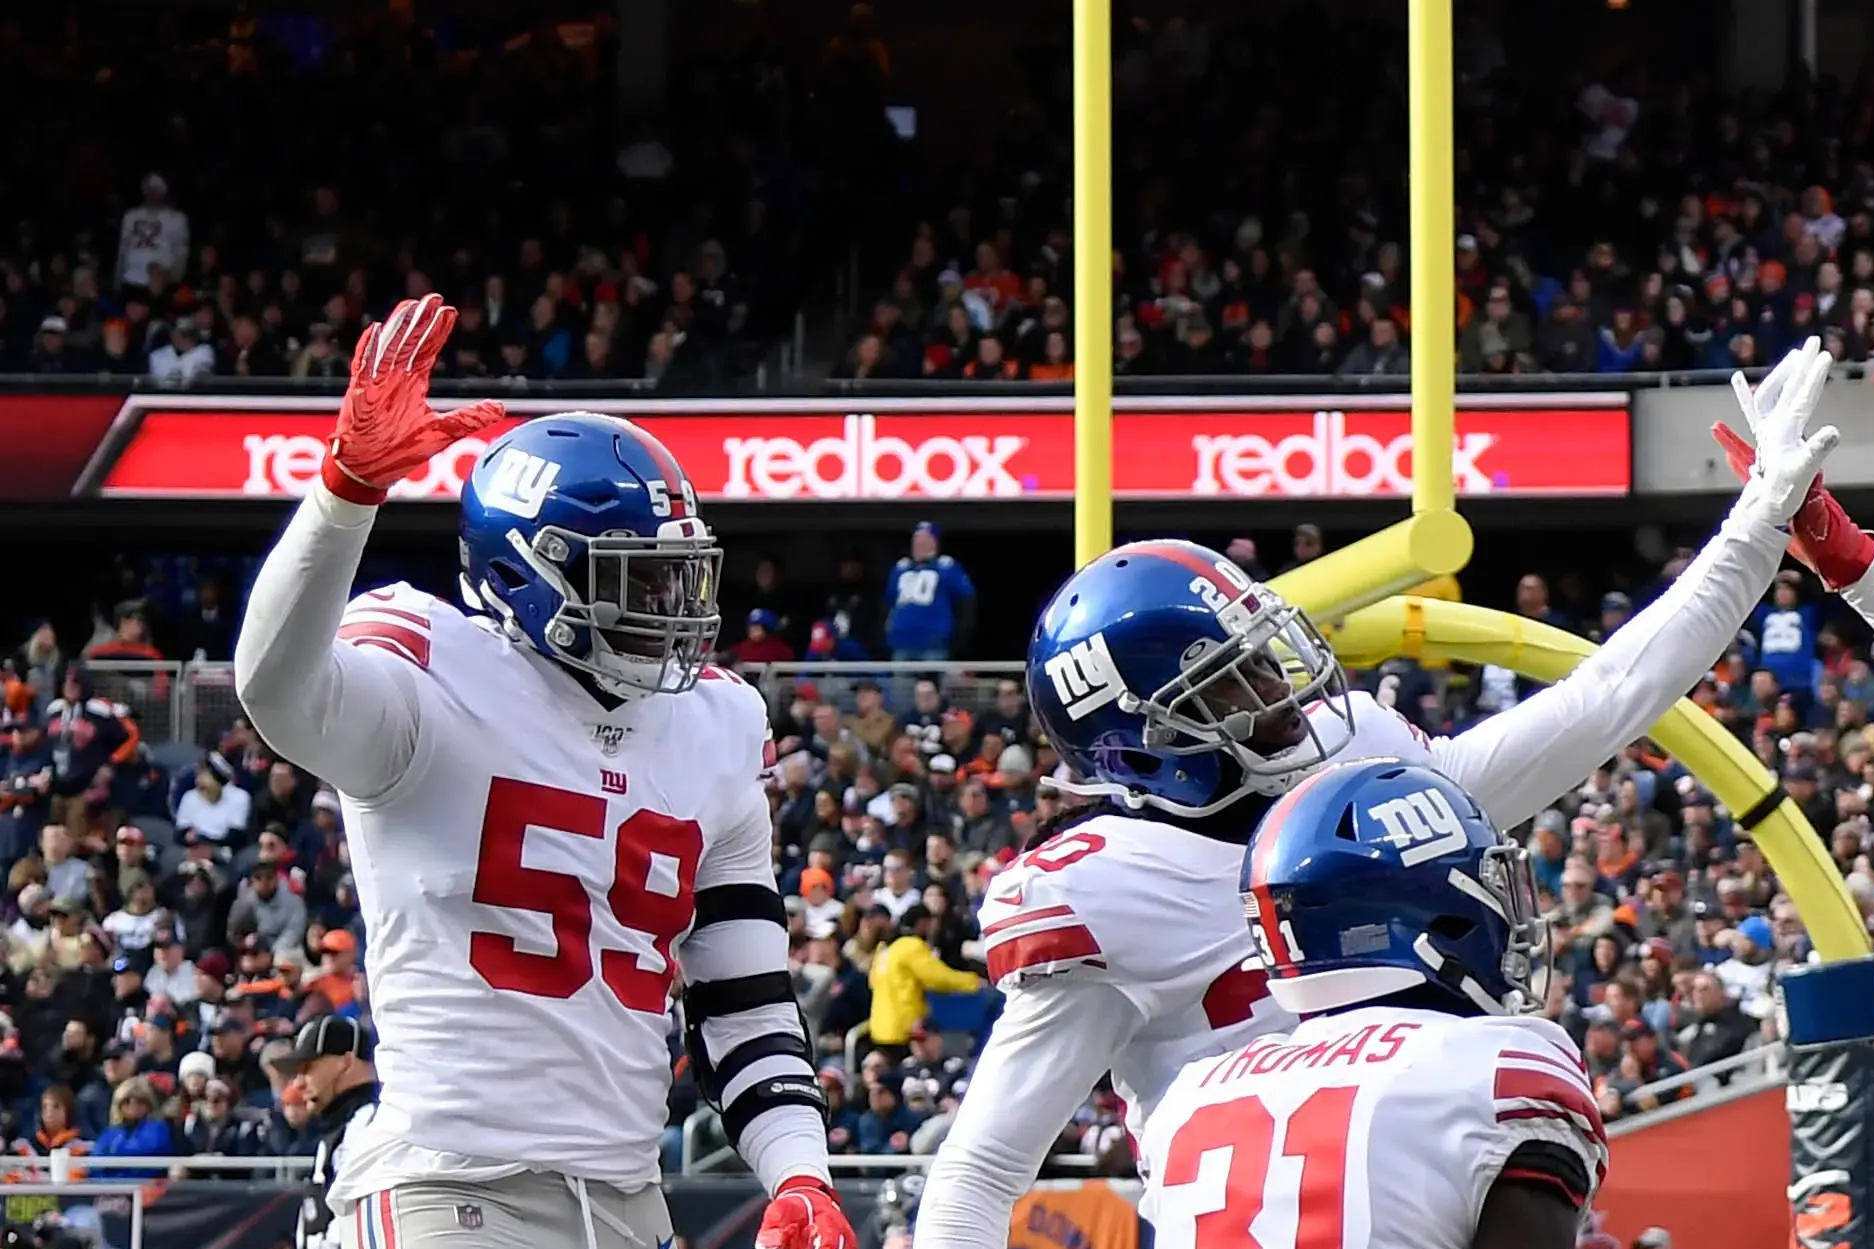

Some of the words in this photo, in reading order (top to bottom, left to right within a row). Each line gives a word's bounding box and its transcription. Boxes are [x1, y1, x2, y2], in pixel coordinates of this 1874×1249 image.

[646, 479, 698, 518] 59
[1189, 560, 1250, 612] 20
[599, 768, 628, 796] ny
[468, 774, 705, 1016] 59
[1252, 920, 1306, 967] 31
